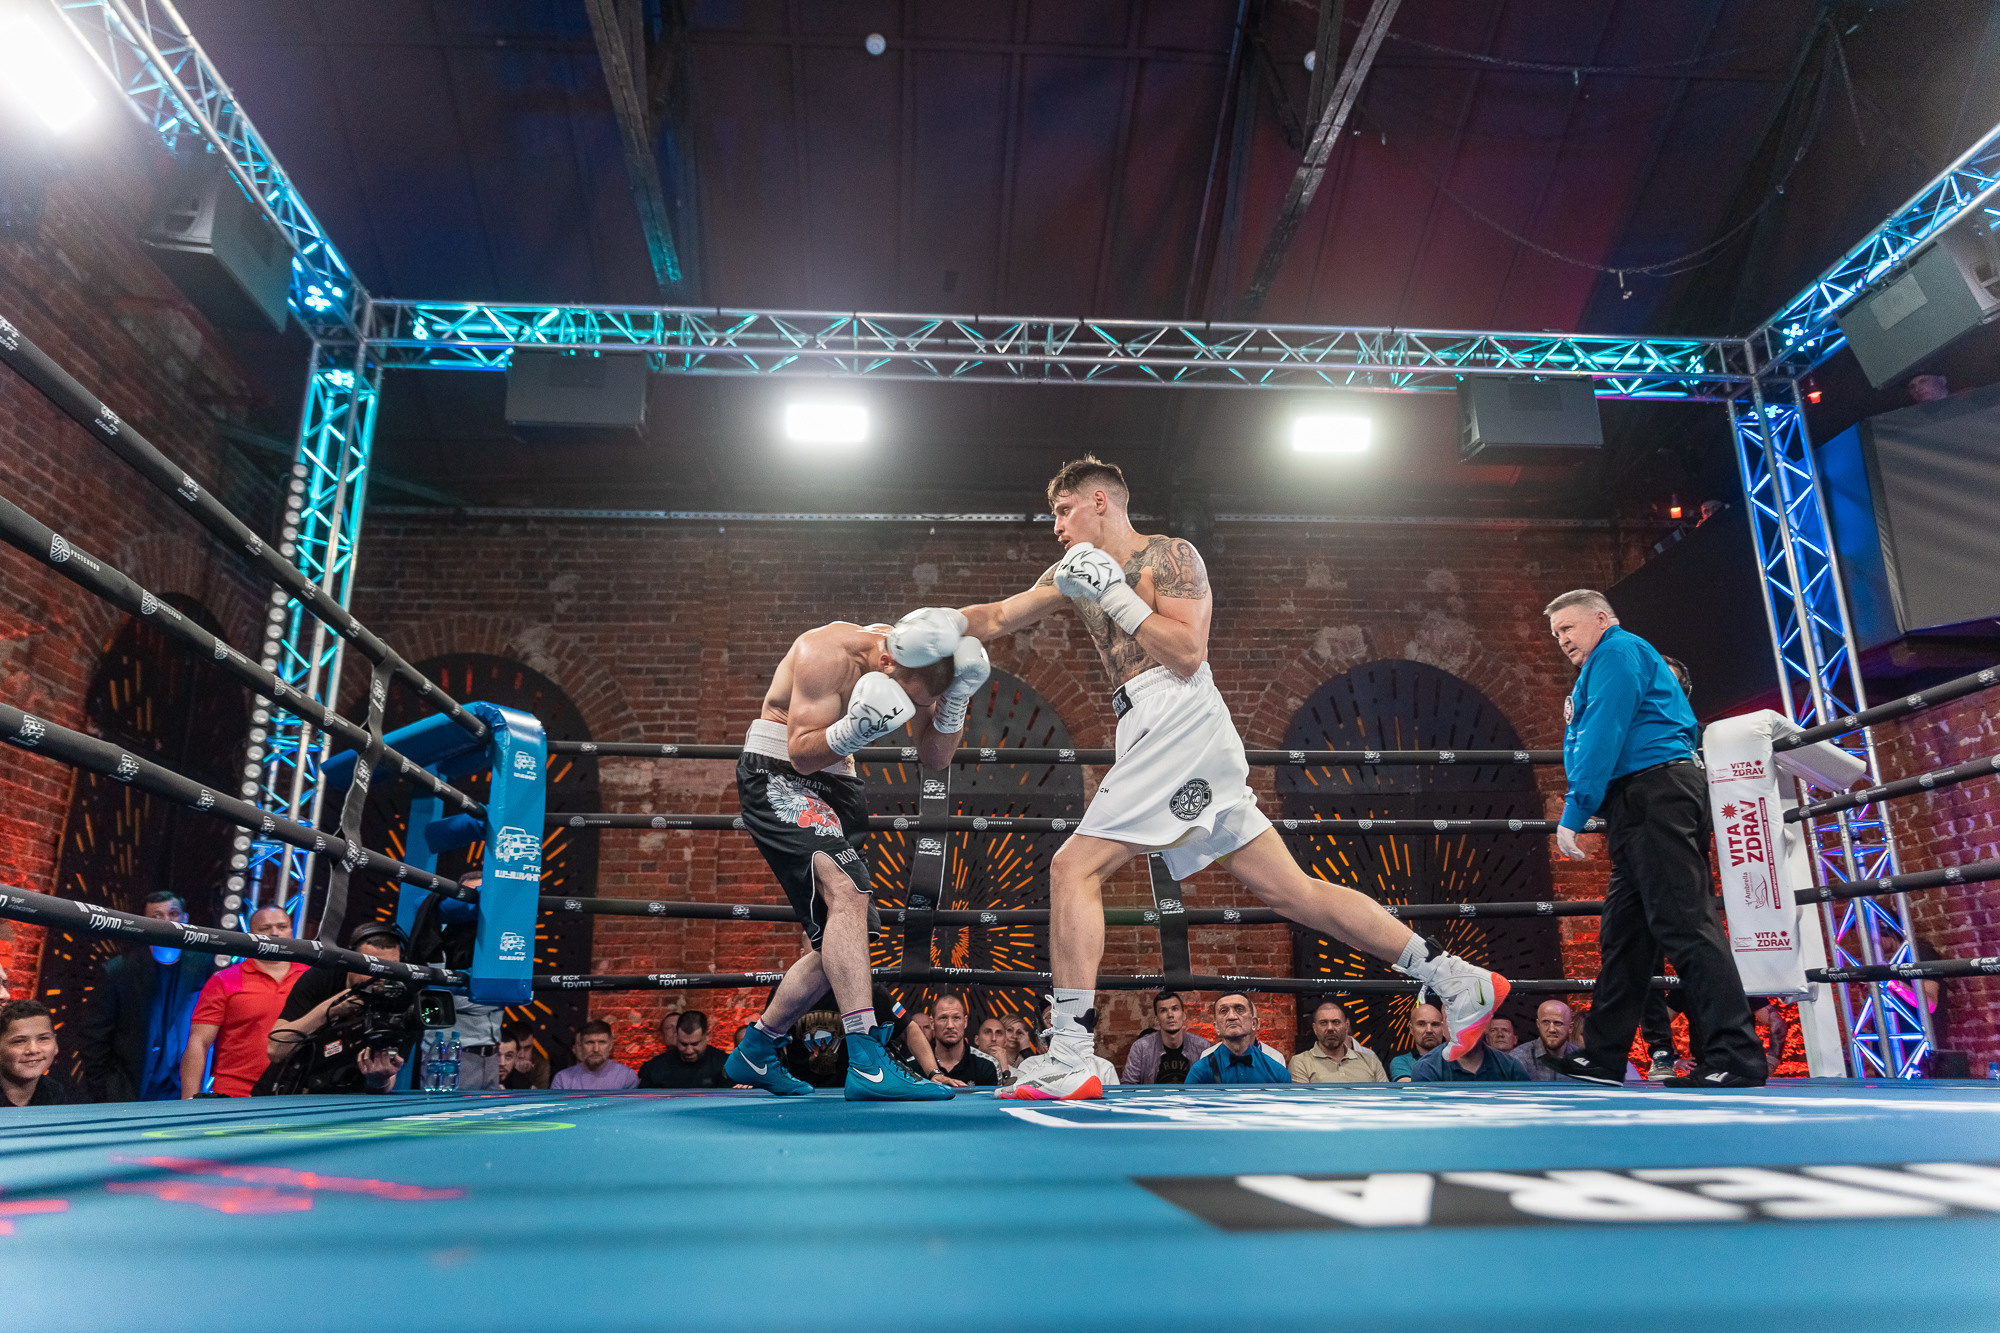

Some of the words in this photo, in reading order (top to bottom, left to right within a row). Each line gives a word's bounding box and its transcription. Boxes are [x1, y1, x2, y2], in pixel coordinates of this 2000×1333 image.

[1730, 761, 1753, 770] VITA
[1732, 767, 1765, 777] ZDRAV
[1739, 800, 1765, 864] ZDRAV
[1727, 823, 1745, 868] VITA
[1754, 931, 1778, 939] VITA
[1757, 938, 1790, 947] ZDRAV
